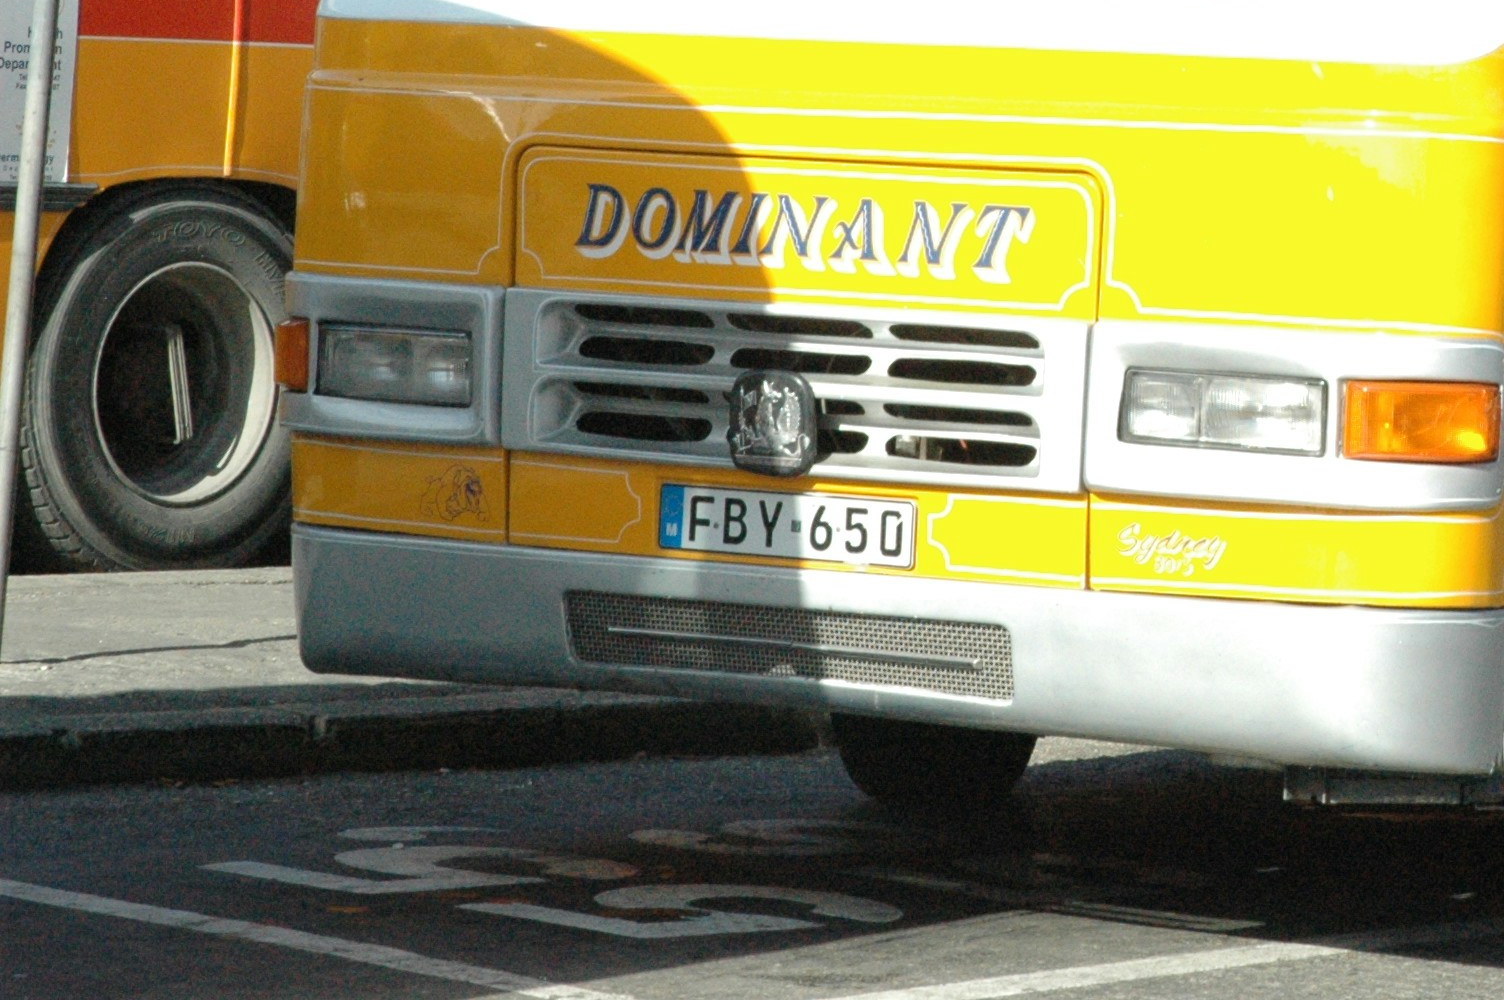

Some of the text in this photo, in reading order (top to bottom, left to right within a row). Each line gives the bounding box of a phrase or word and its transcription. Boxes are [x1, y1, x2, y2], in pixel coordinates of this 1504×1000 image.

[153, 220, 246, 247] TOYO
[574, 182, 1034, 283] DOMINANT
[665, 523, 678, 536] M
[688, 495, 902, 557] FBY 650
[1116, 521, 1229, 570] Sydney
